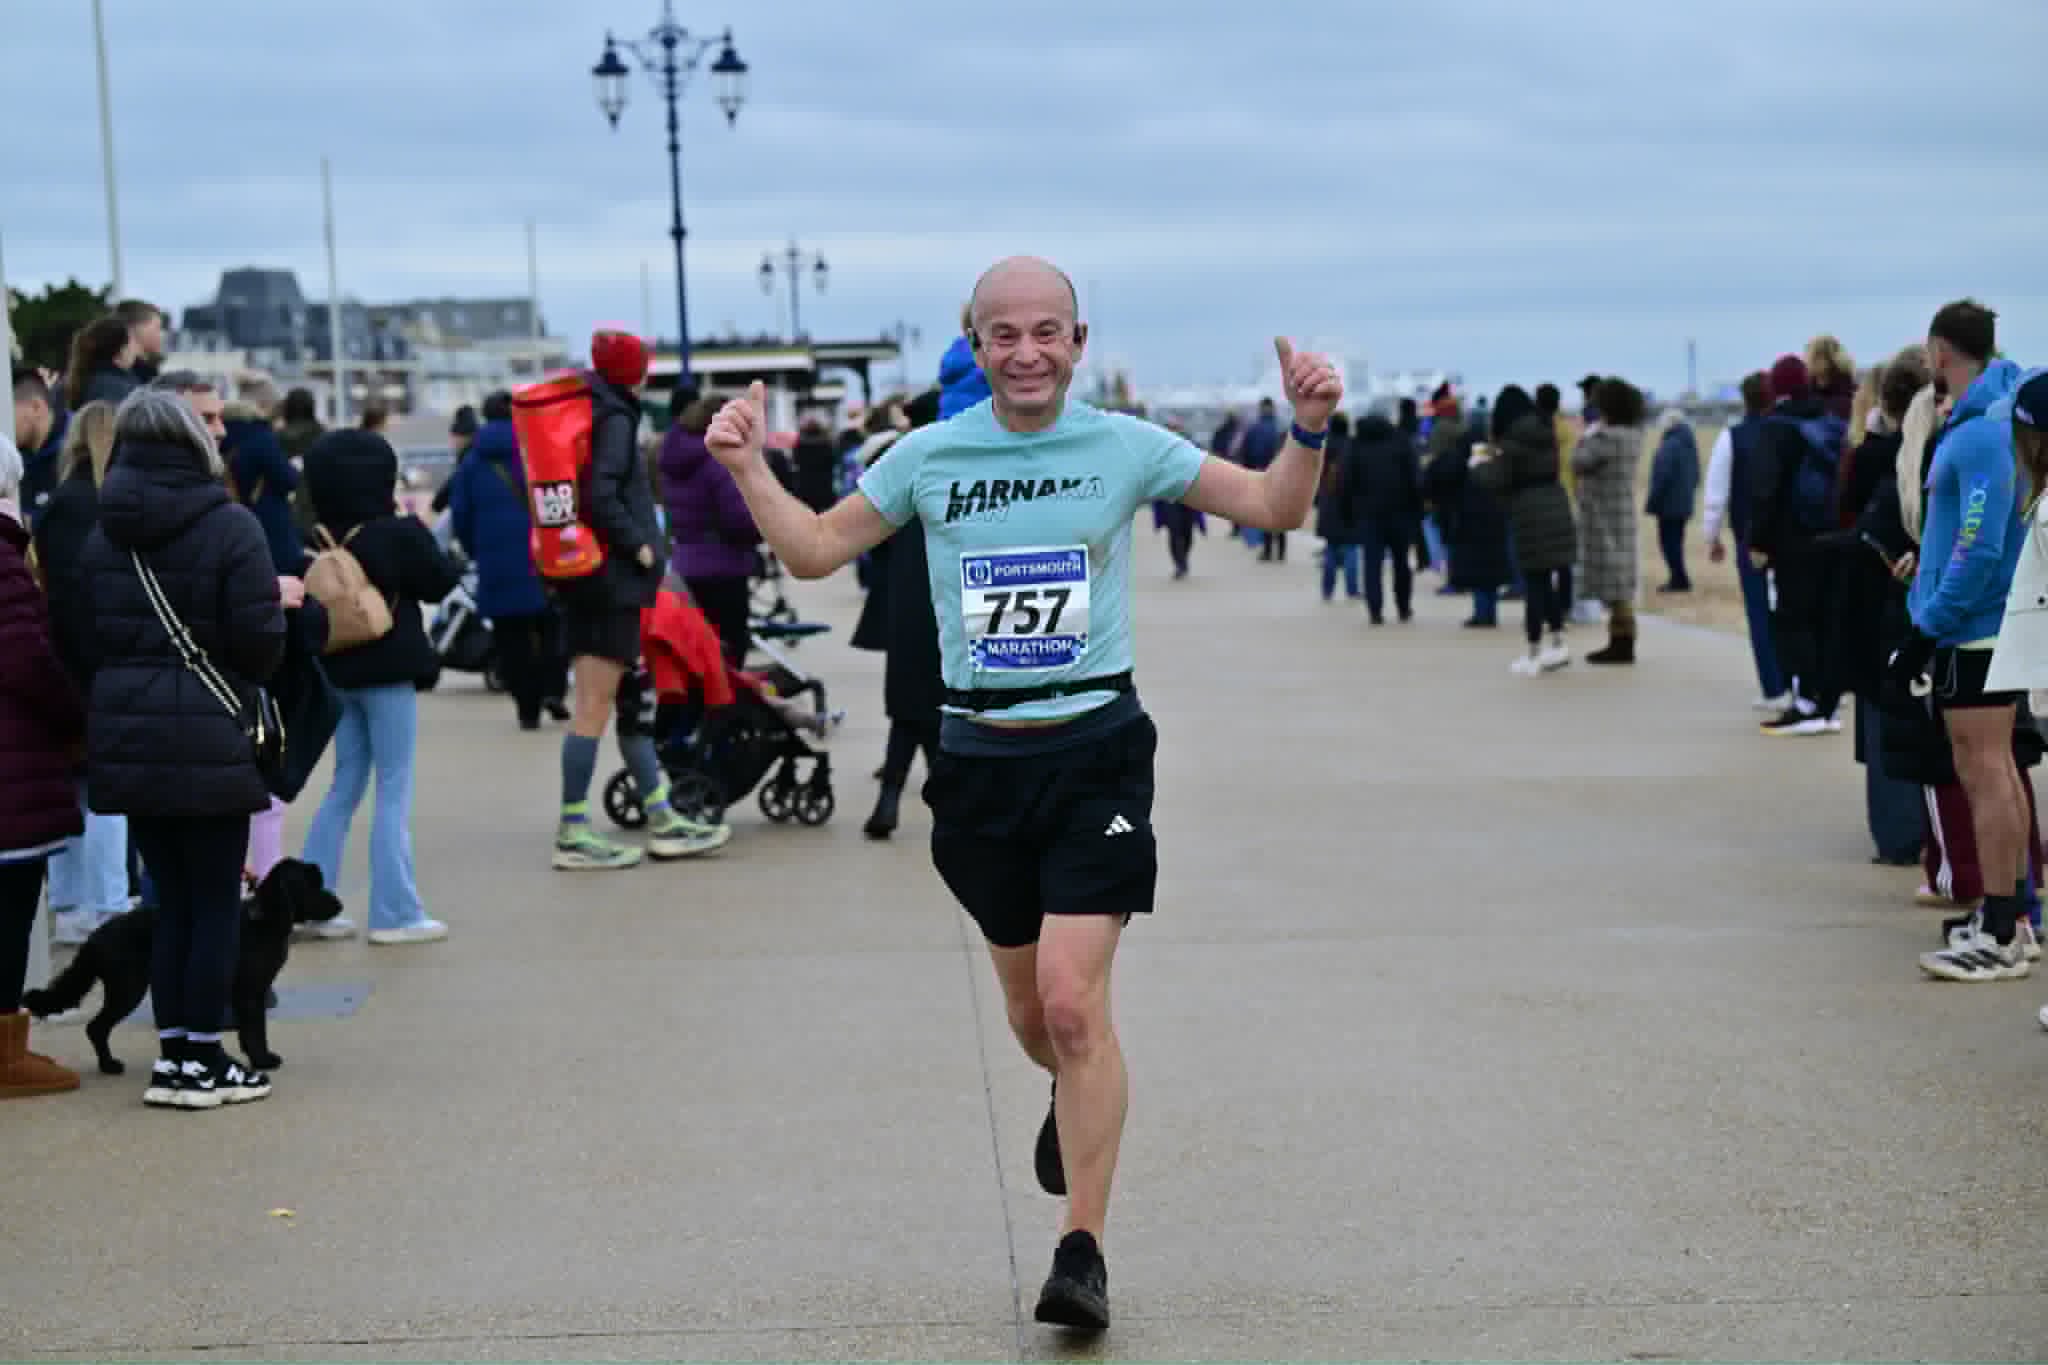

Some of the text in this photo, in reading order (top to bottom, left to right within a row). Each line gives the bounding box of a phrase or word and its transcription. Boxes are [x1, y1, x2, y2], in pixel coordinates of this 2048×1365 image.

[948, 477, 1104, 501] LARNAKA
[994, 561, 1082, 577] PORTSMOUTH
[983, 588, 1072, 635] 757
[986, 640, 1073, 657] MARATHON
